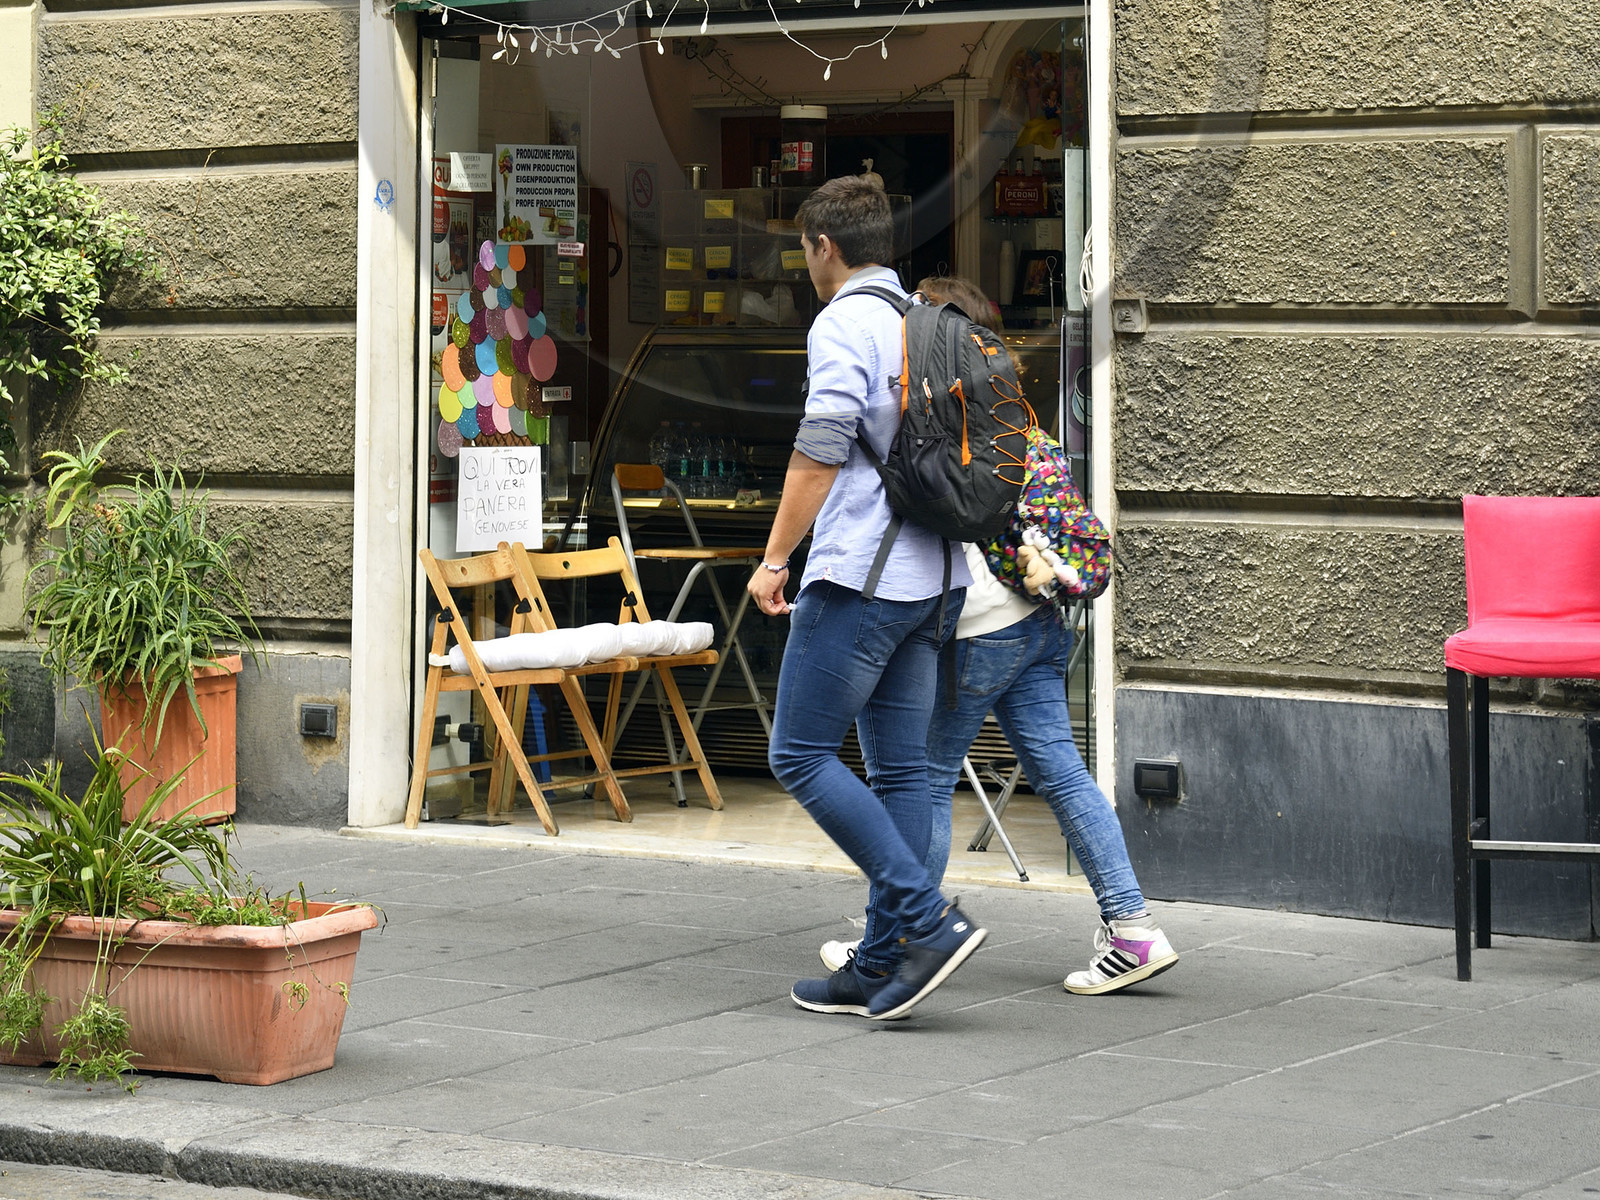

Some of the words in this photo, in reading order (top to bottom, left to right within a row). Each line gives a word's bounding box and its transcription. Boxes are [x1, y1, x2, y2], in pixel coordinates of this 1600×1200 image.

[516, 149, 551, 159] PRODUZIONE
[533, 164, 575, 172] PRODUCTION
[516, 199, 534, 207] PROPE
[536, 199, 575, 207] PRODUCTION
[464, 456, 495, 480] QUI
[501, 457, 538, 475] TROVI
[477, 480, 490, 491] LA
[495, 478, 525, 491] VERA
[463, 495, 526, 520] PANERA
[475, 519, 529, 535] GENOVESE
